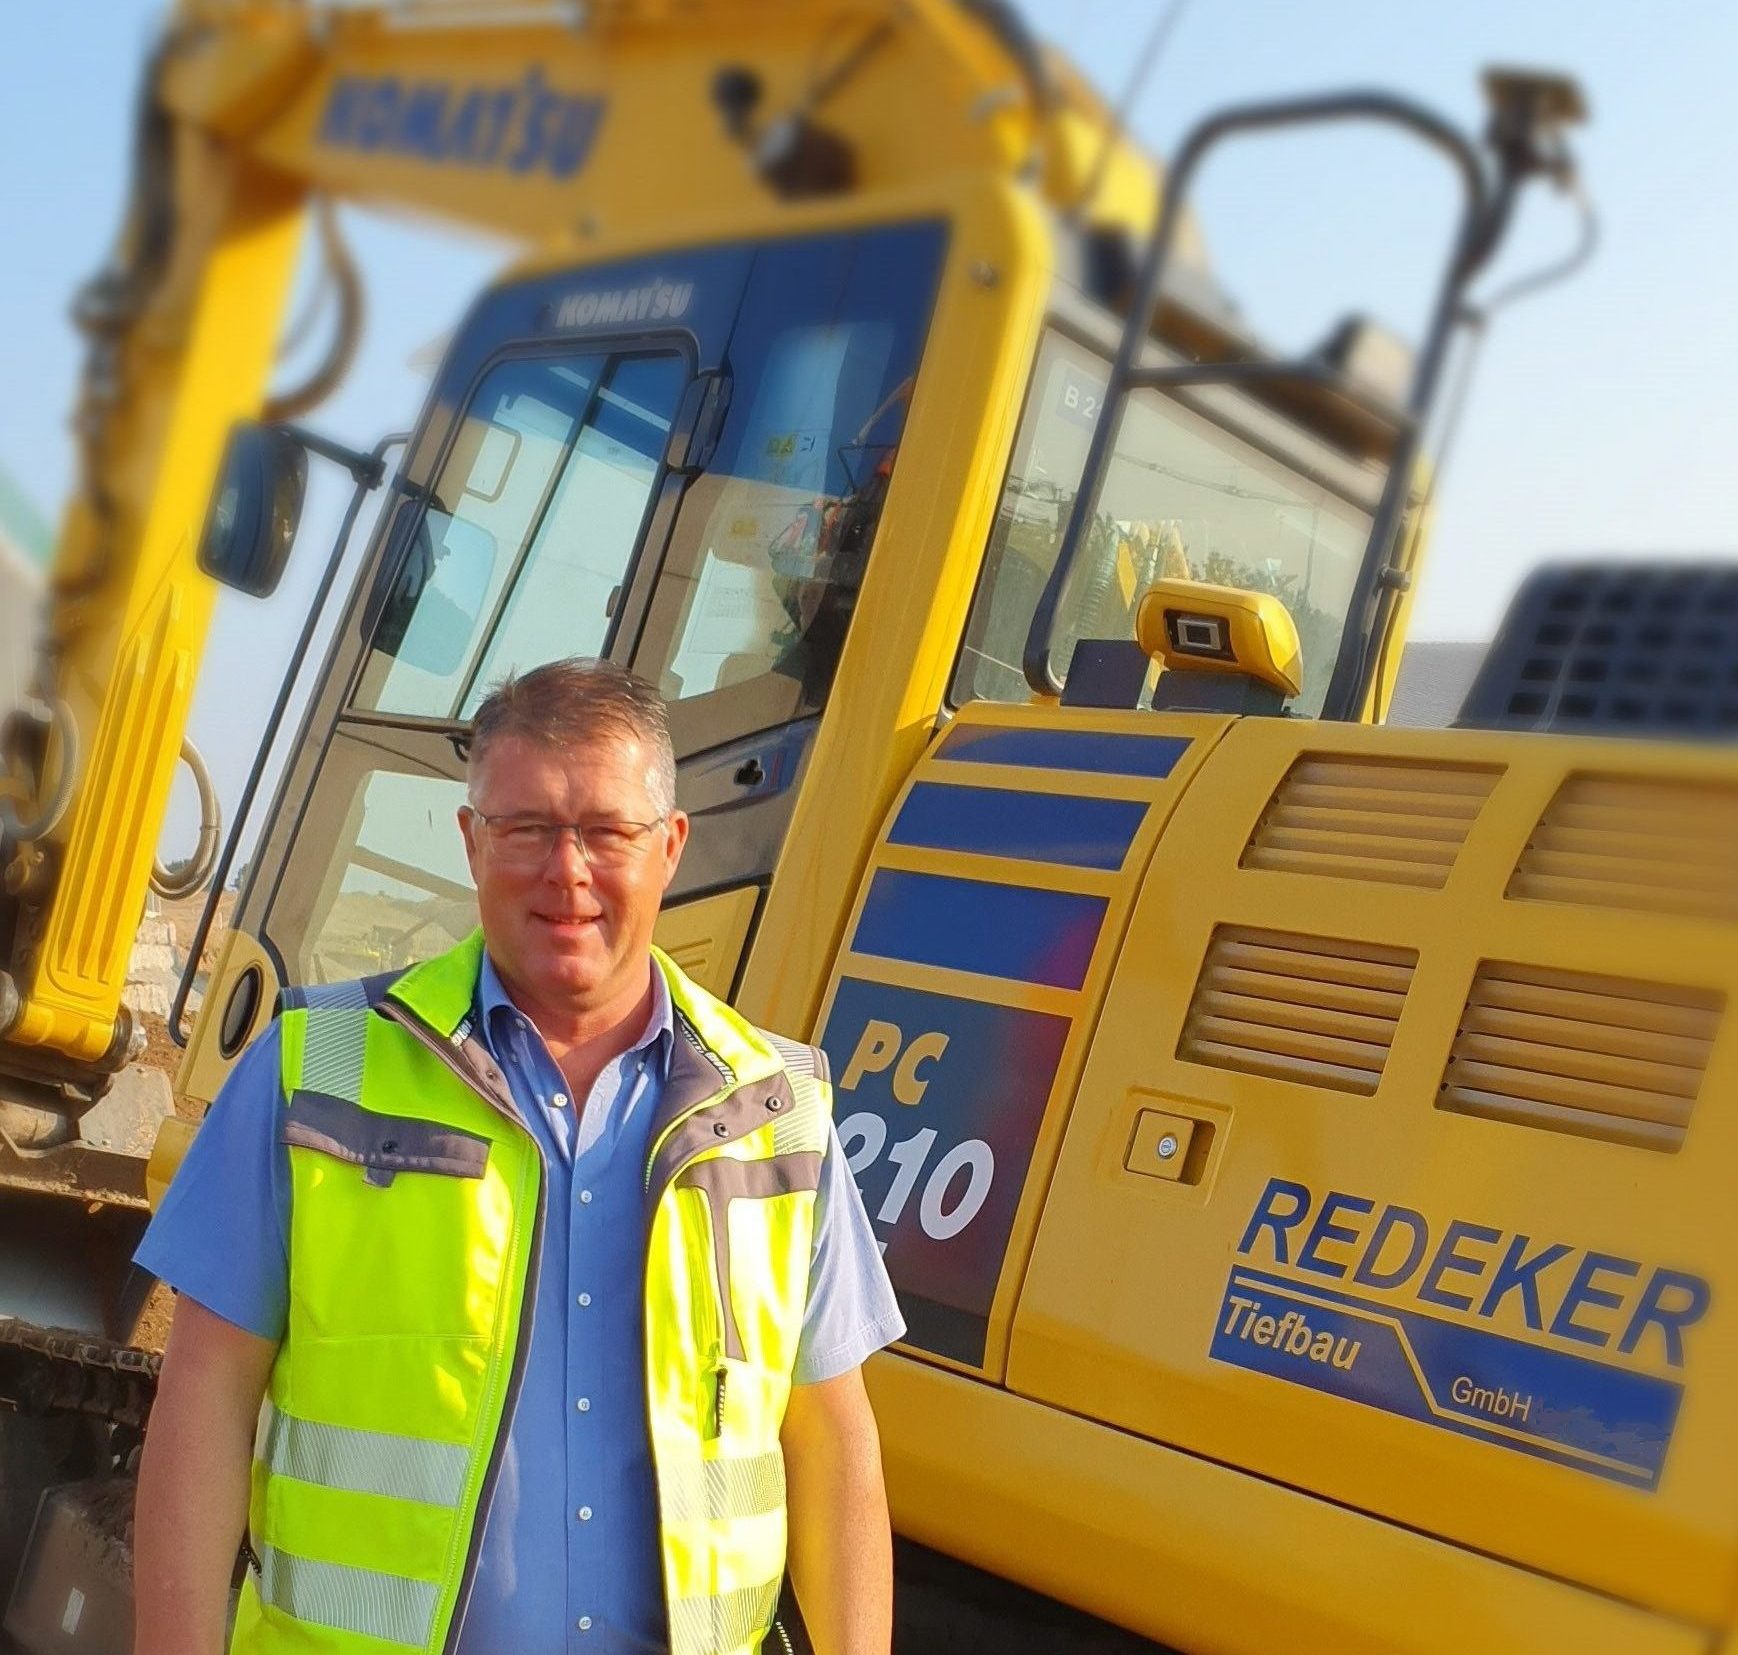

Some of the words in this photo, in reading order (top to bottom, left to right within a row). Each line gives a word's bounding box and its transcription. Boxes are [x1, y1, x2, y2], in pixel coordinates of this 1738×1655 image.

[319, 65, 606, 180] KOMATSU
[556, 278, 694, 327] KOMATSU
[1064, 385, 1080, 409] B
[838, 1019, 950, 1106] PC
[1236, 1177, 1712, 1369] REDEKER
[1222, 1296, 1362, 1371] Tiefbau
[1451, 1376, 1533, 1423] GmbH
